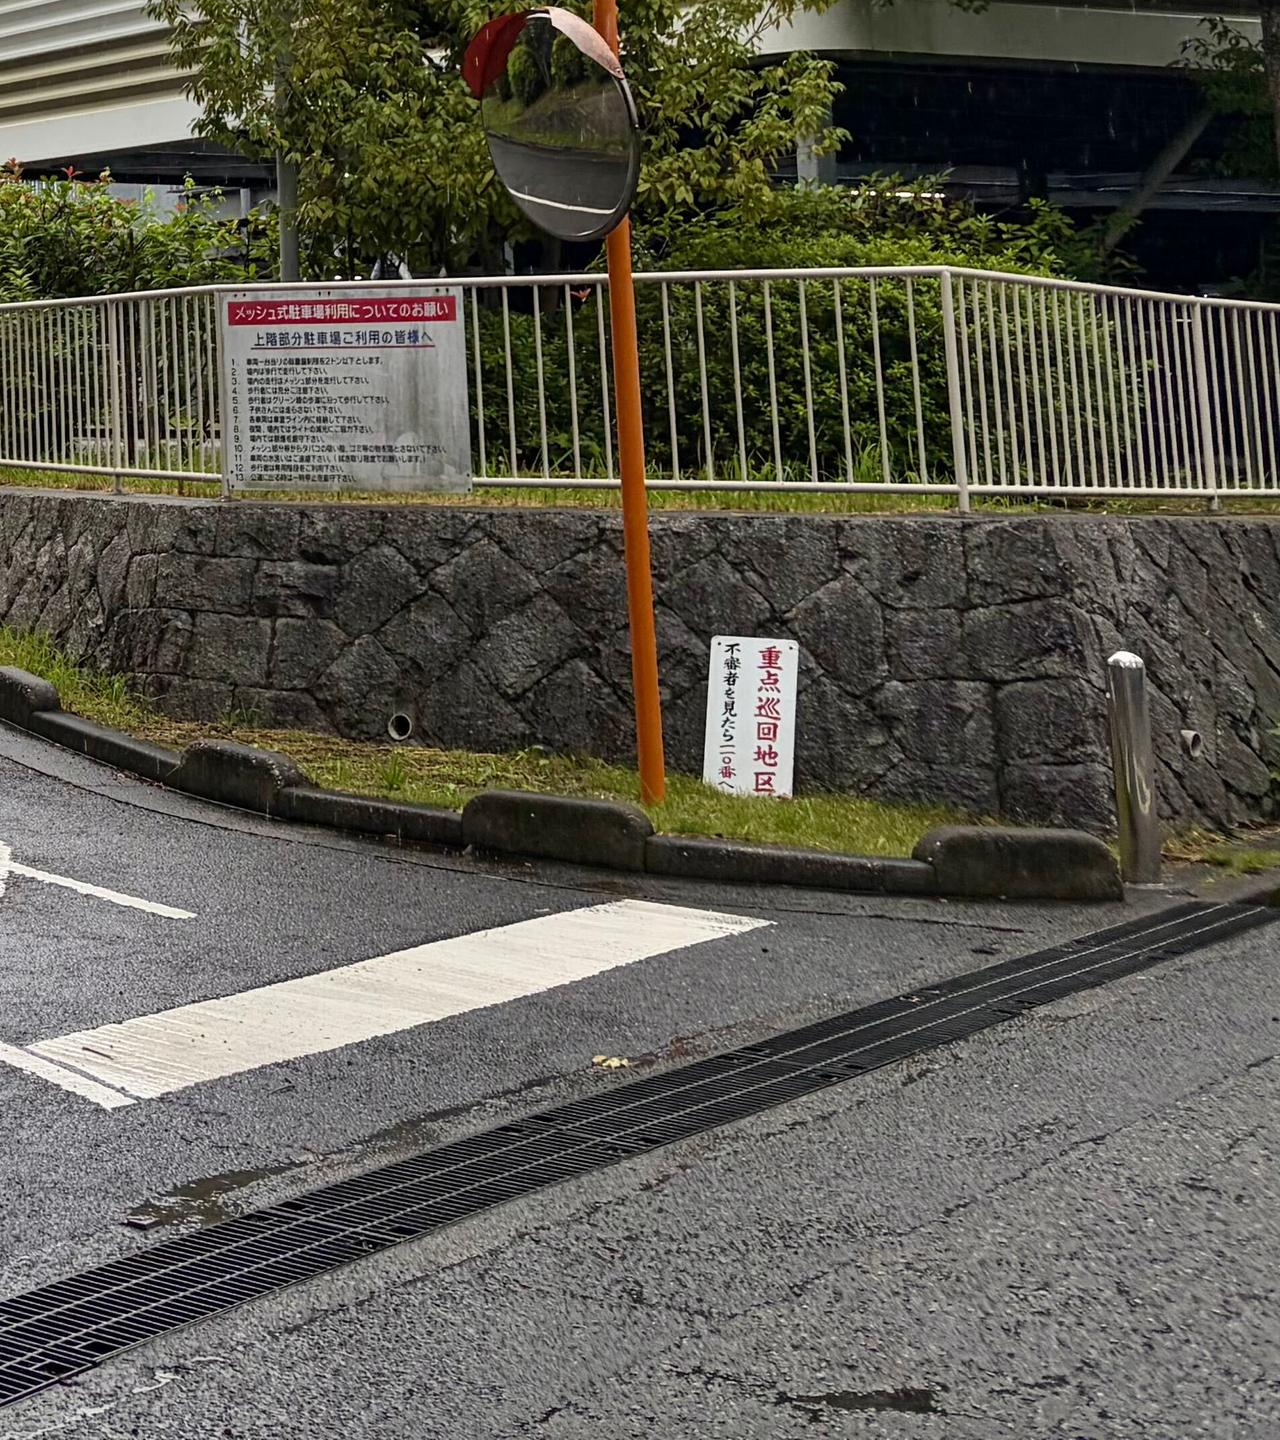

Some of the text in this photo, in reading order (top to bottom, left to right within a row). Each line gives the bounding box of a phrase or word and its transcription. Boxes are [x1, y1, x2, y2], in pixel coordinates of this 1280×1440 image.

[235, 302, 449, 320] メッシュ式駐車場利用についてのお願い
[255, 330, 433, 346] 上階部分駐車場ご利用の皆様へ
[753, 645, 783, 792] 重点巡回地区
